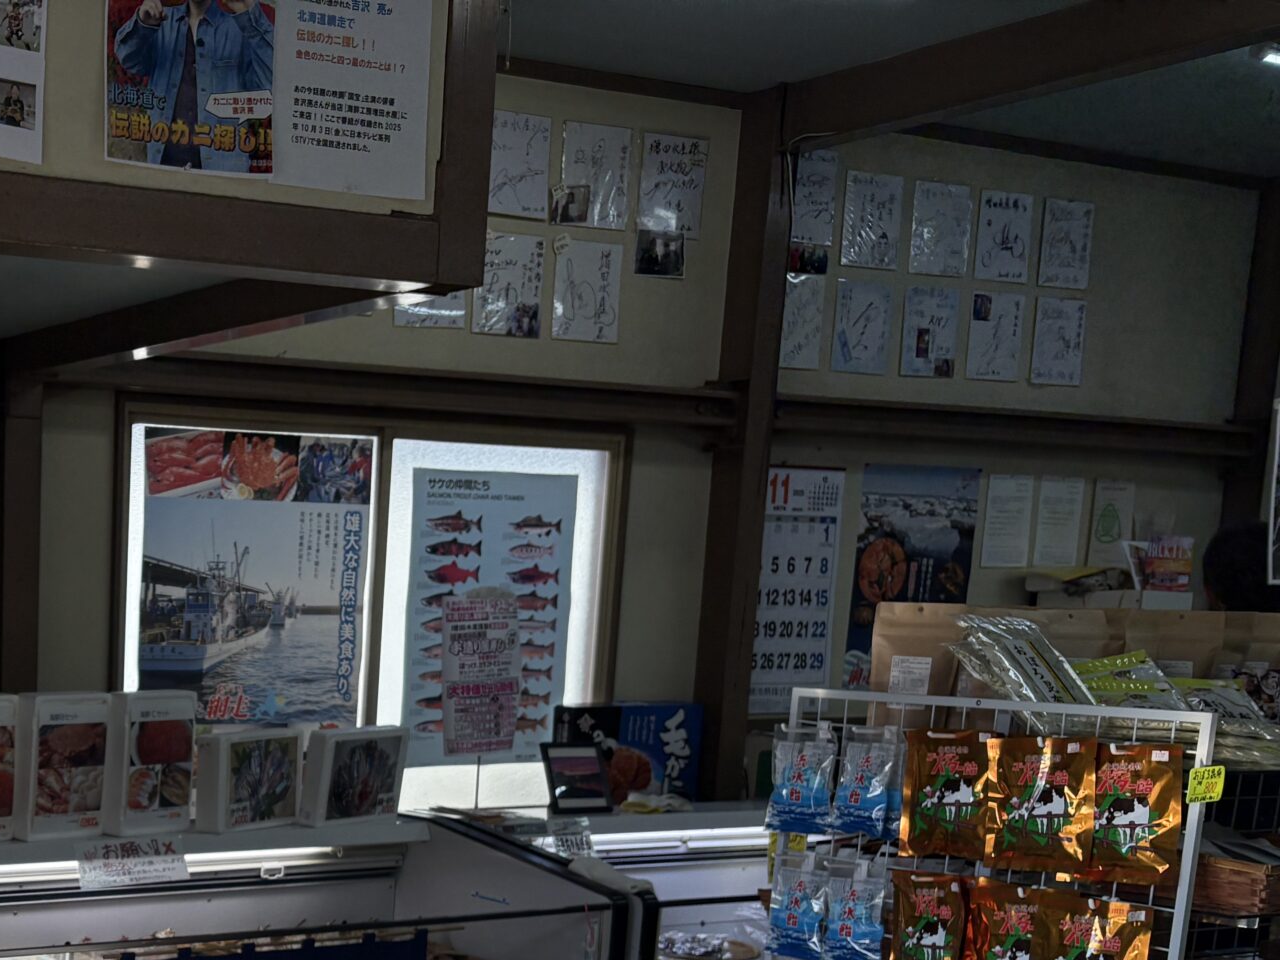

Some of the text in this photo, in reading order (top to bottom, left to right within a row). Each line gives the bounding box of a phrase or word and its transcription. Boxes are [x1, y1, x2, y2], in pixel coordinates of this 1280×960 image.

[109, 83, 167, 110] 北海道で
[427, 477, 491, 492] サケの仲間たち
[770, 473, 791, 505] 11
[823, 525, 830, 543] 1
[771, 556, 828, 575] 5 6 7 8
[336, 510, 362, 702] 雄大な自然に美食あり。
[766, 589, 828, 607] 12 13 14 15
[763, 621, 826, 639] 19 20 21 22
[760, 653, 824, 671] 26 27 28 29
